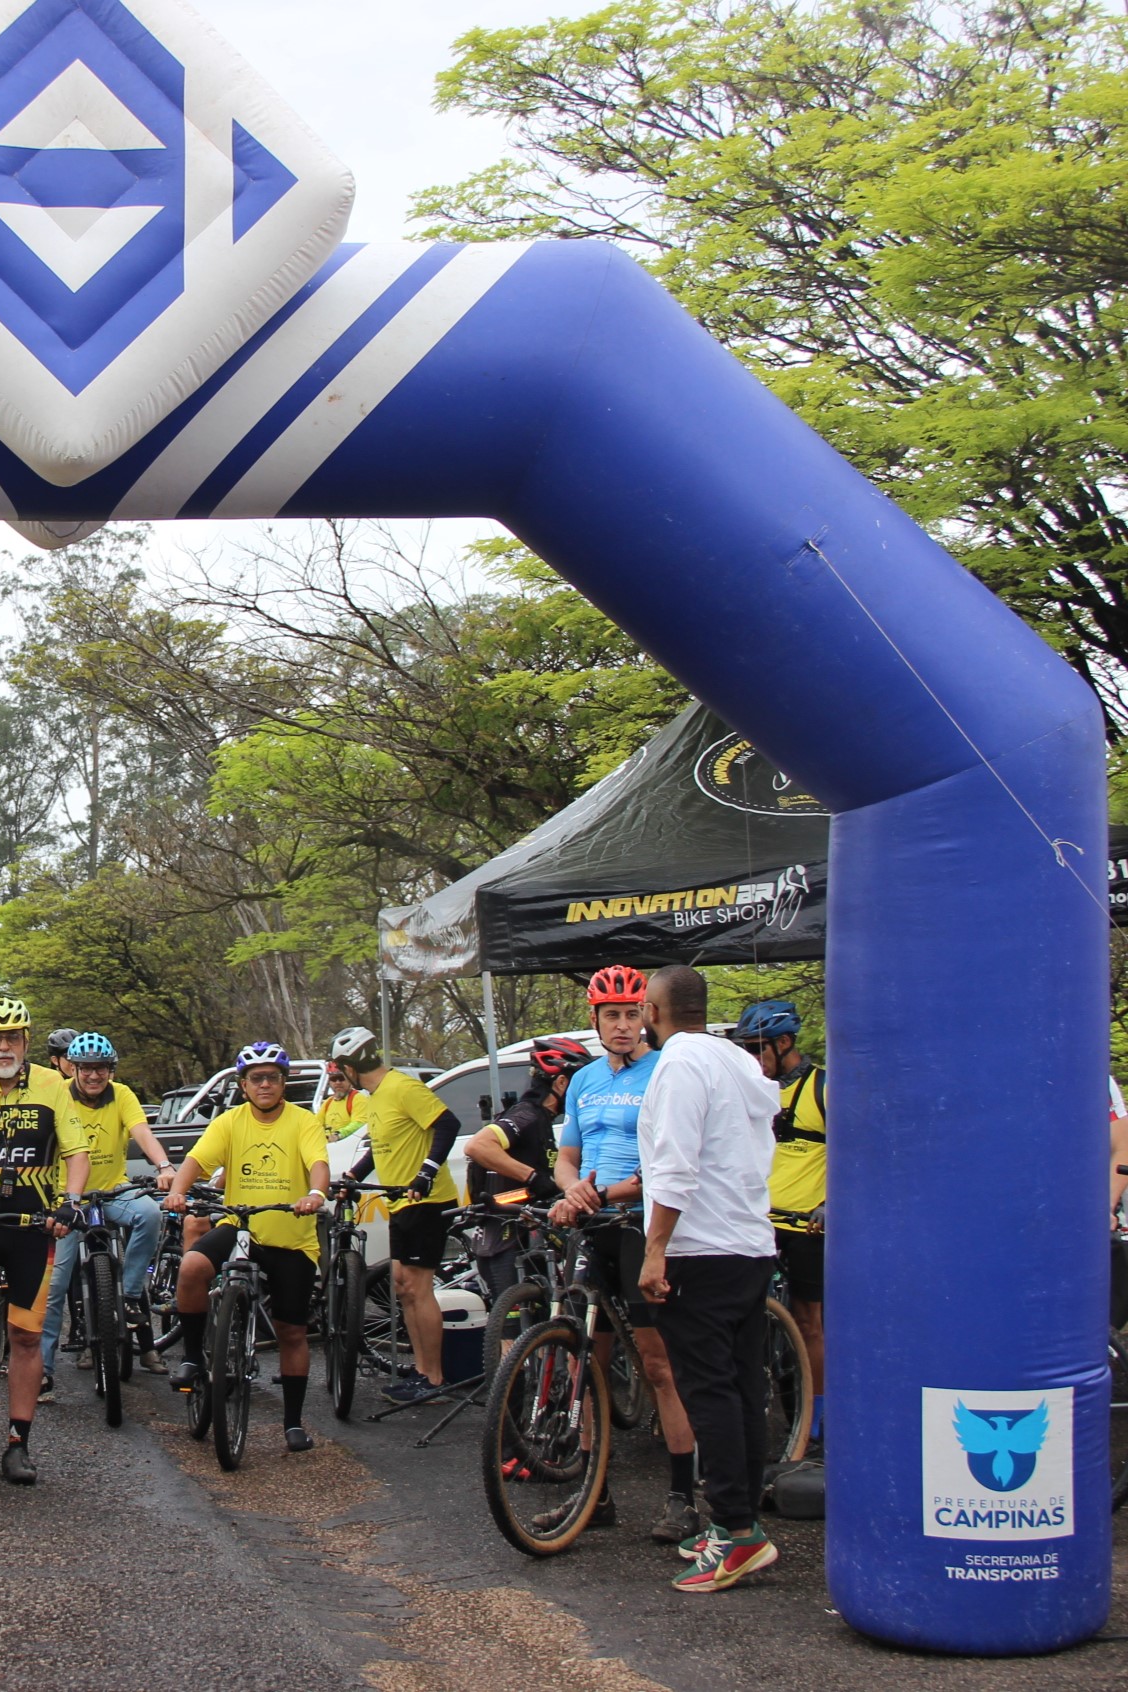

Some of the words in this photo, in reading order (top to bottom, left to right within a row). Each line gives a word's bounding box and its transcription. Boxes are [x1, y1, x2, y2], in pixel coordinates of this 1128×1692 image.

[713, 740, 752, 785] INNOVATI
[675, 910, 712, 928] BIKE
[717, 904, 767, 924] SHOP
[933, 1496, 1039, 1509] PREFEITURA
[1049, 1495, 1066, 1506] DE
[934, 1506, 1066, 1529] CAMPINAS
[965, 1554, 1042, 1566] SECRETARIA
[1043, 1552, 1059, 1564] DE
[944, 1566, 1060, 1582] TRANSPORTES
